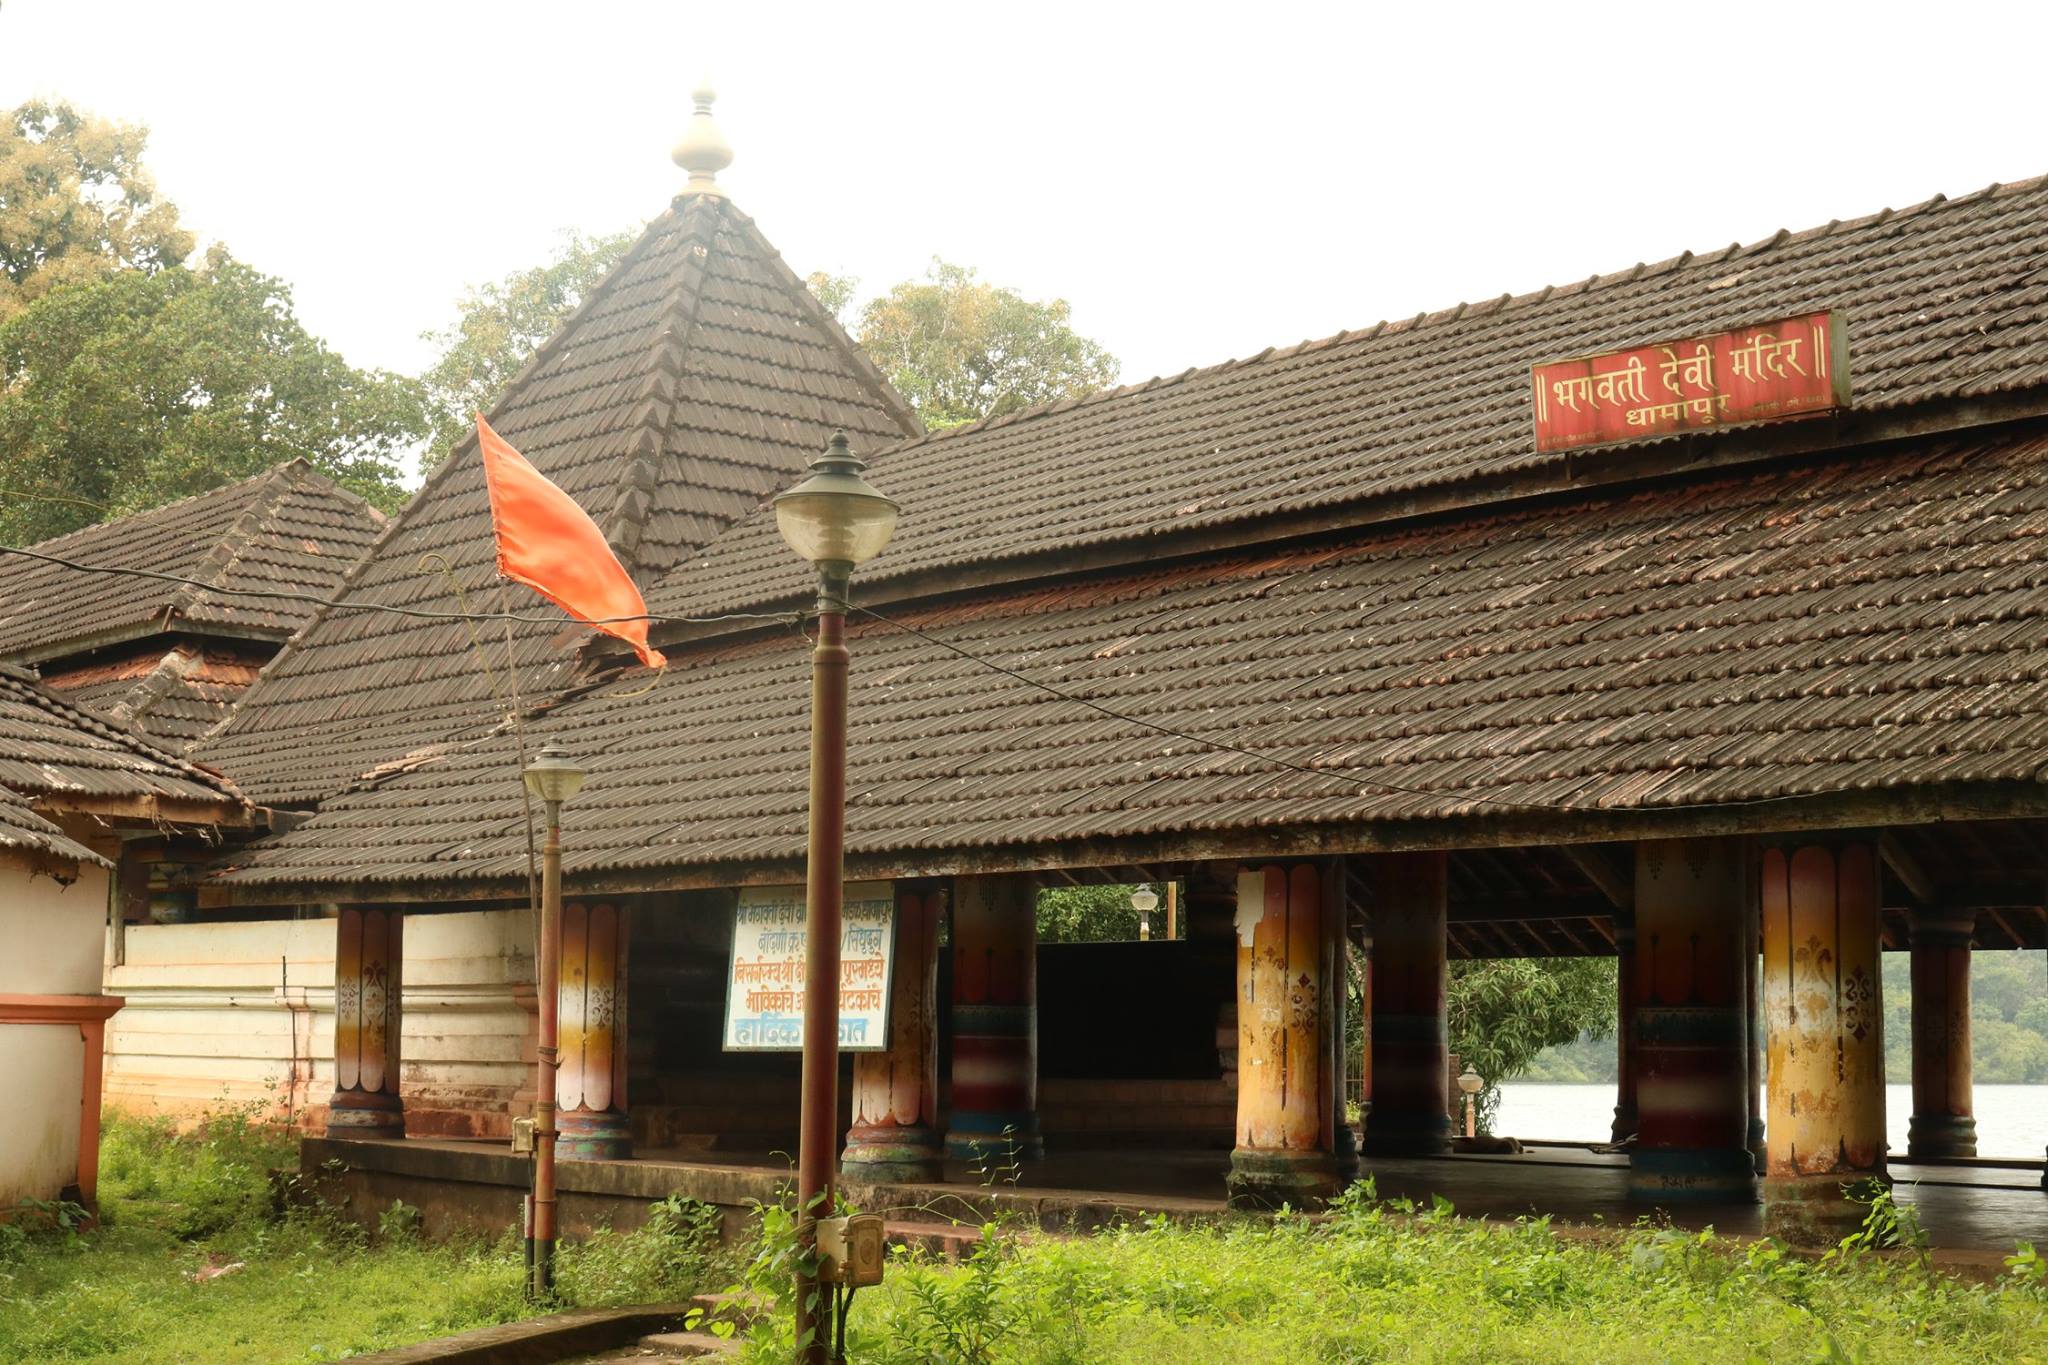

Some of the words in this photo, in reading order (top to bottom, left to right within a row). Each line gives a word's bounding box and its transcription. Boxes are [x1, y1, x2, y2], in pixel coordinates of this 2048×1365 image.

[1553, 356, 1650, 413] भगवती
[1660, 344, 1718, 396] देवी
[1729, 334, 1807, 384] मंदिर
[1626, 394, 1730, 426] धामापूर
[734, 1011, 802, 1045] हार्दिक
